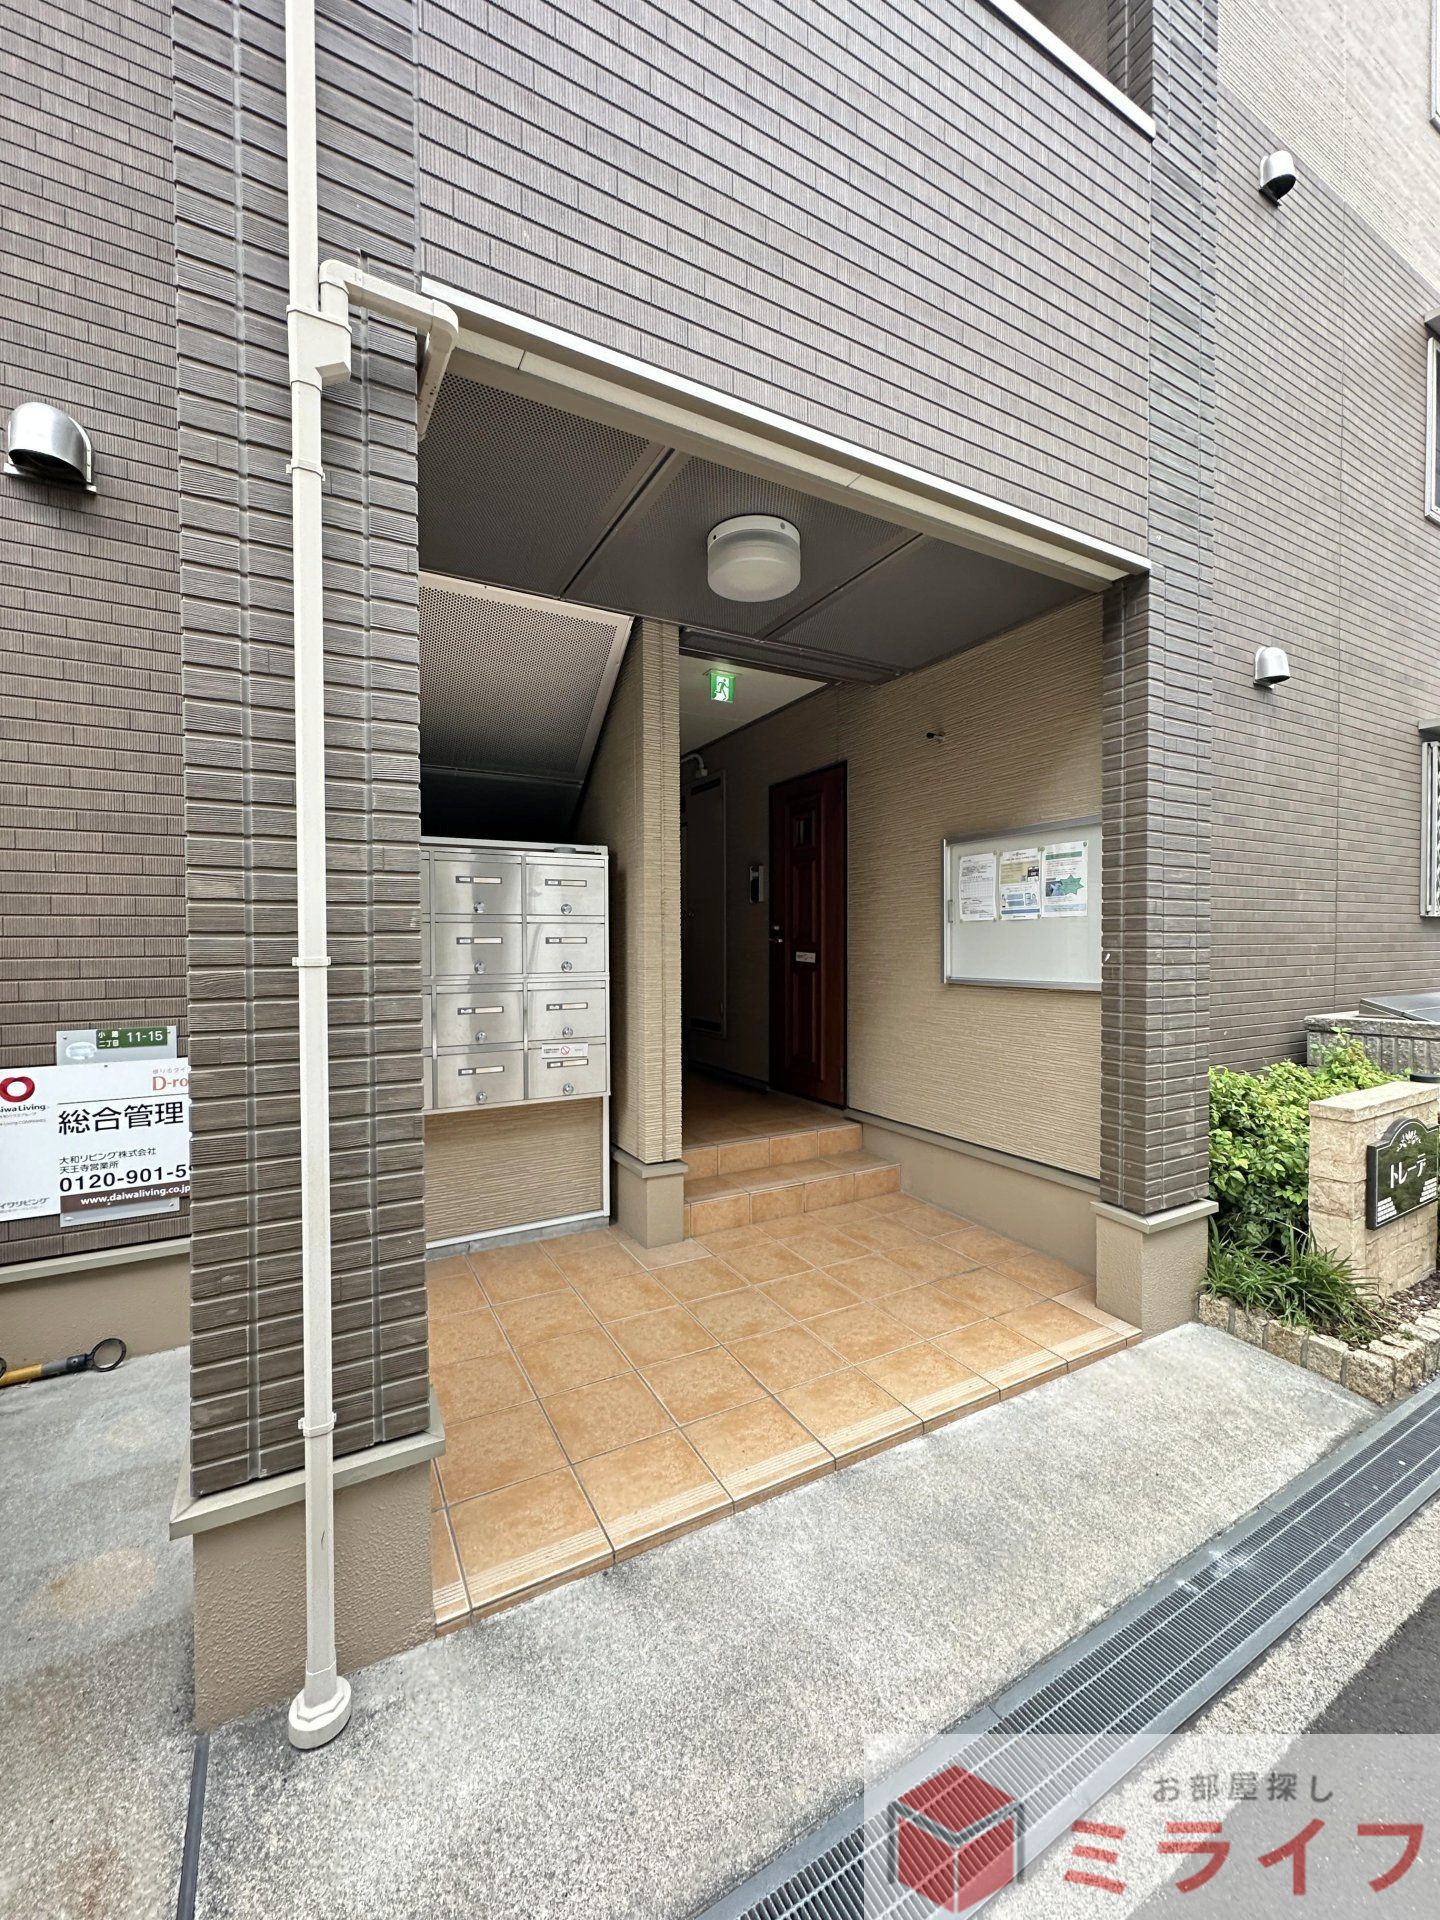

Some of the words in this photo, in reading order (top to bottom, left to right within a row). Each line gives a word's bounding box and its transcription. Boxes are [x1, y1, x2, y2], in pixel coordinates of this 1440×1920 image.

[98, 1039, 119, 1047] 二丁目
[126, 1030, 163, 1043] 11-15
[18, 1103, 46, 1111] Living
[58, 1101, 184, 1135] 総合管理
[59, 1147, 157, 1165] 大和リビング株式会社
[59, 1160, 119, 1175] 天王寺営業所
[80, 1184, 191, 1205] www.daiwaliving.co.jp
